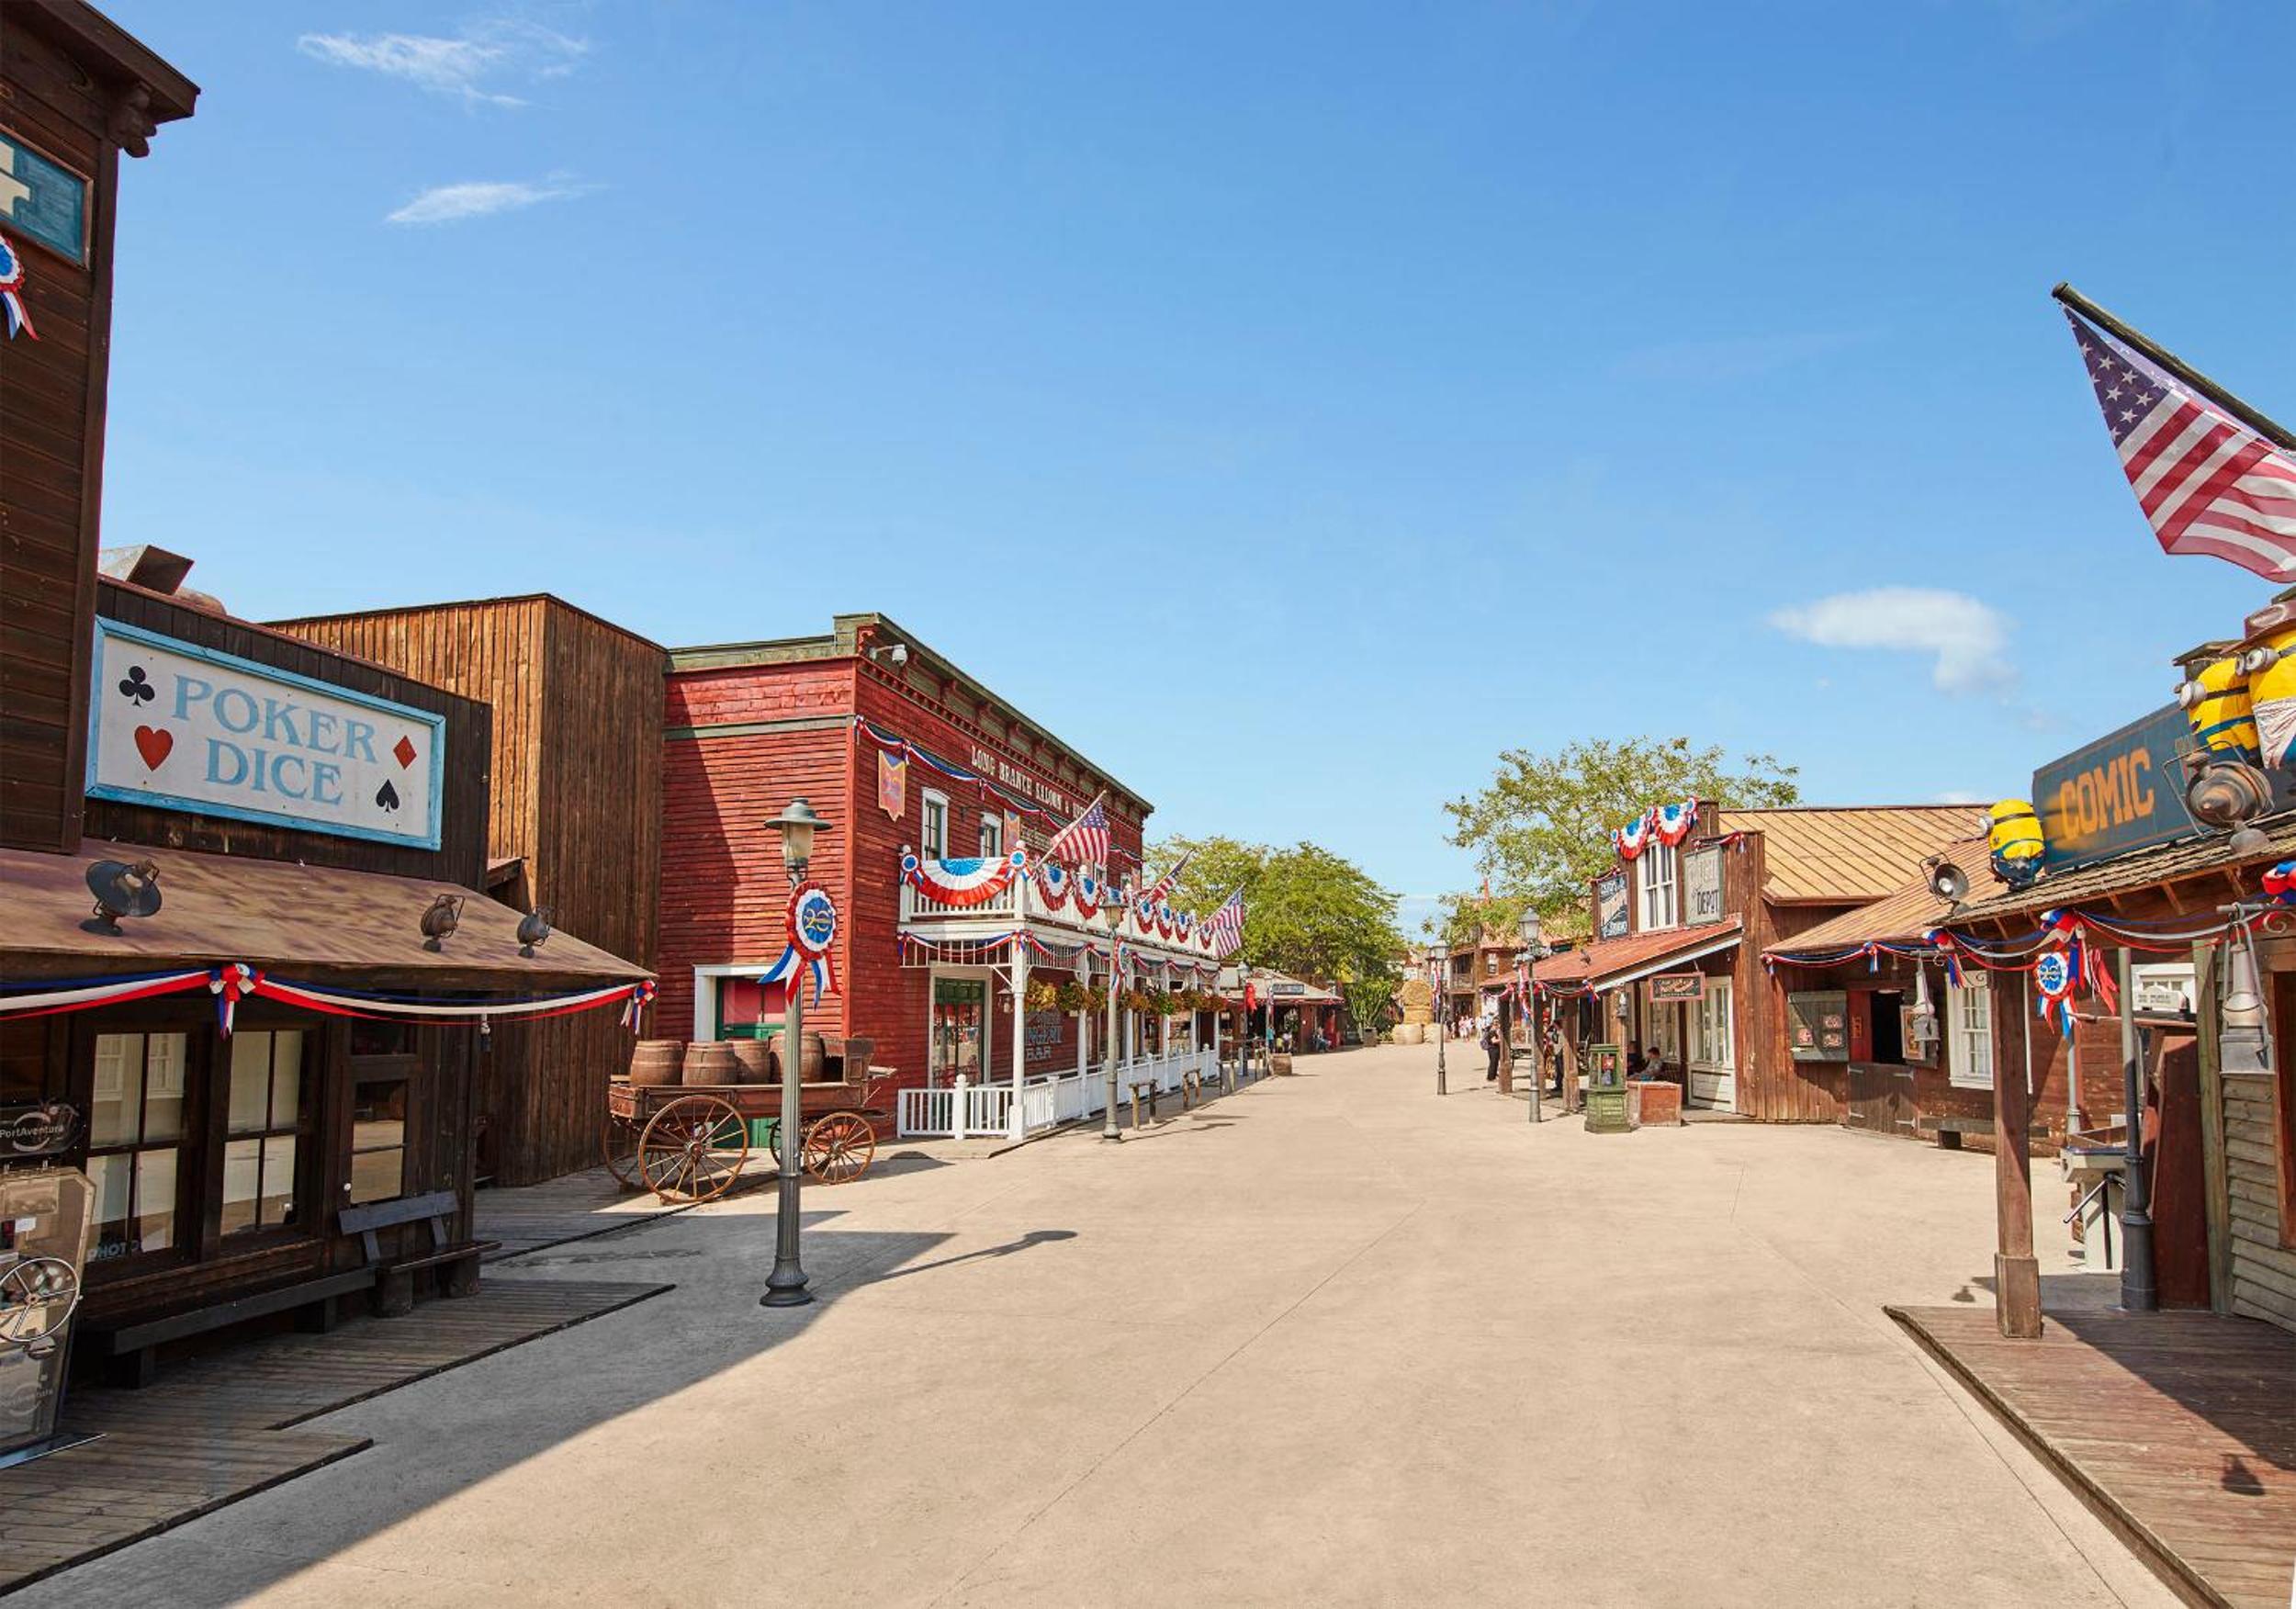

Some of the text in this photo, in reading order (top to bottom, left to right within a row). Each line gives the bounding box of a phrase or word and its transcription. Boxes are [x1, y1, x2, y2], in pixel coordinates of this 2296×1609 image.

[171, 673, 378, 765] POKER
[205, 737, 343, 806] DICE
[2059, 747, 2155, 841] COMIC
[1696, 889, 1719, 916] DEPOT
[0, 1124, 65, 1139] PortAventura
